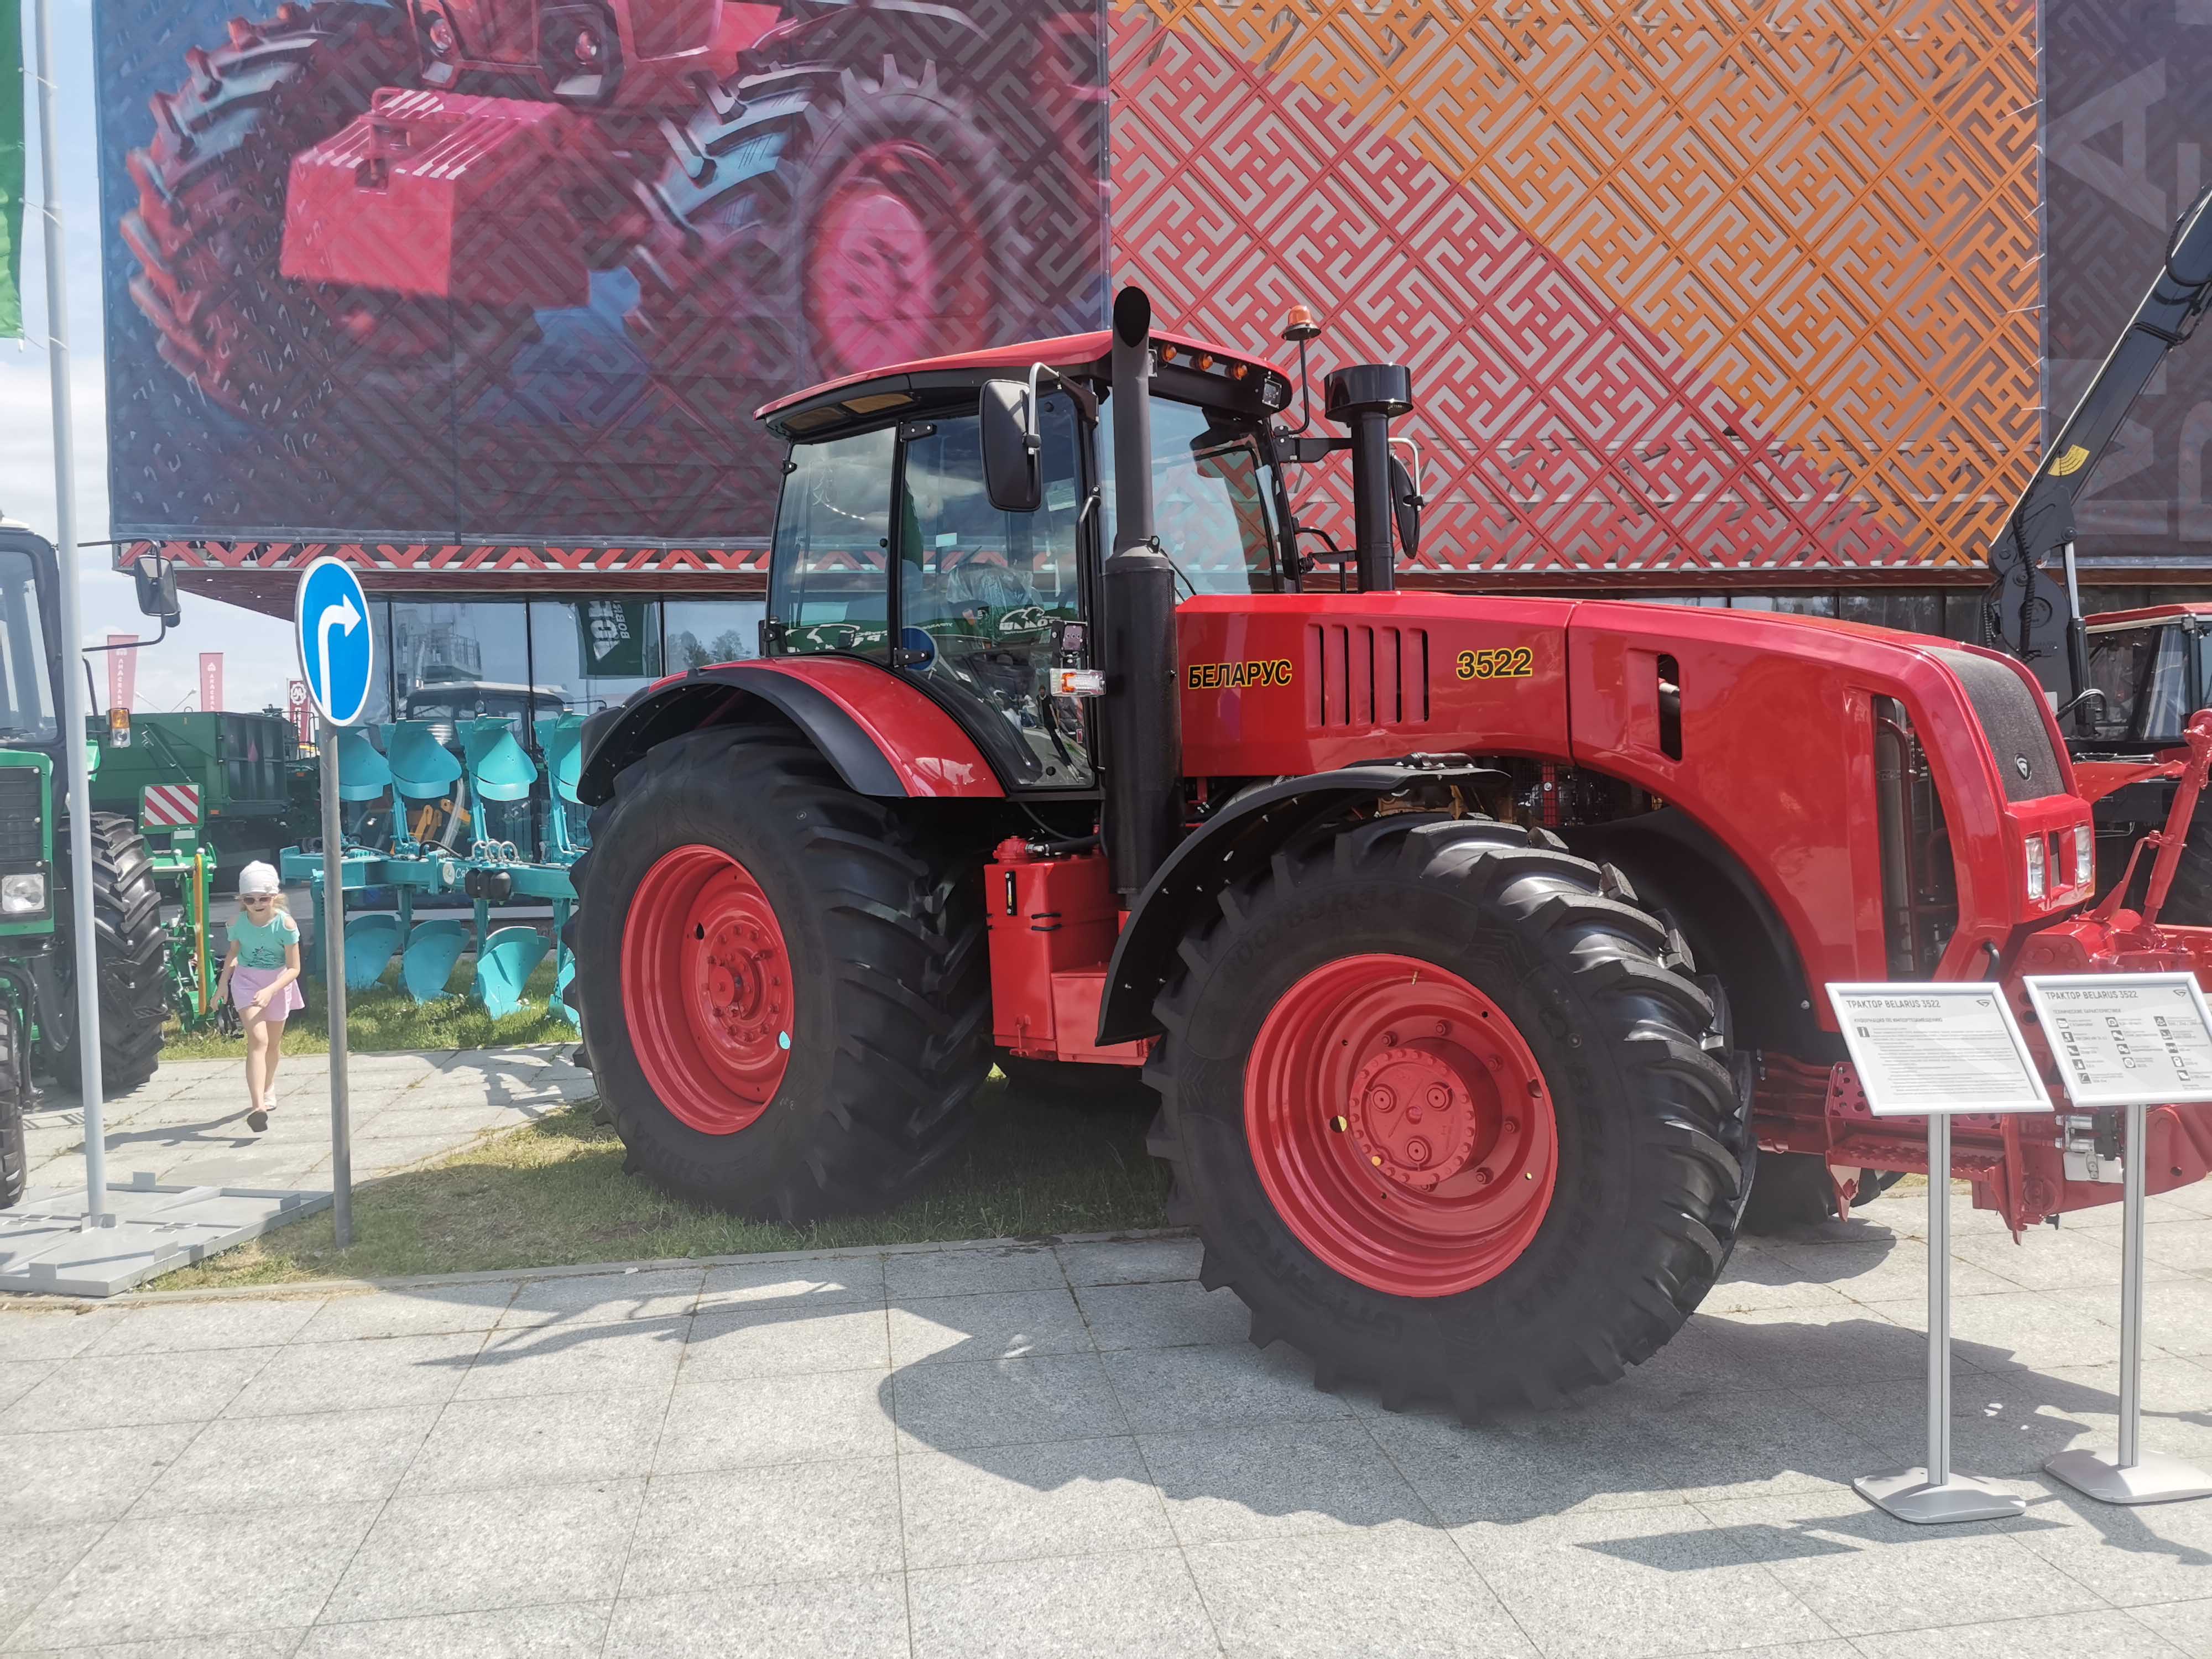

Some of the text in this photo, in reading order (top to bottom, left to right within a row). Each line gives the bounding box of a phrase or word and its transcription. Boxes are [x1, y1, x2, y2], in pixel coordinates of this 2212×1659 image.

[1456, 646, 1533, 681] 3522
[1188, 659, 1293, 690] БЕЛАРУС
[1846, 1000, 1883, 1009] ТРАКТОР
[1885, 1000, 1921, 1008] BELARUS
[2045, 992, 2081, 1000] ТРАКТОР
[2083, 991, 2118, 999] BELARUS
